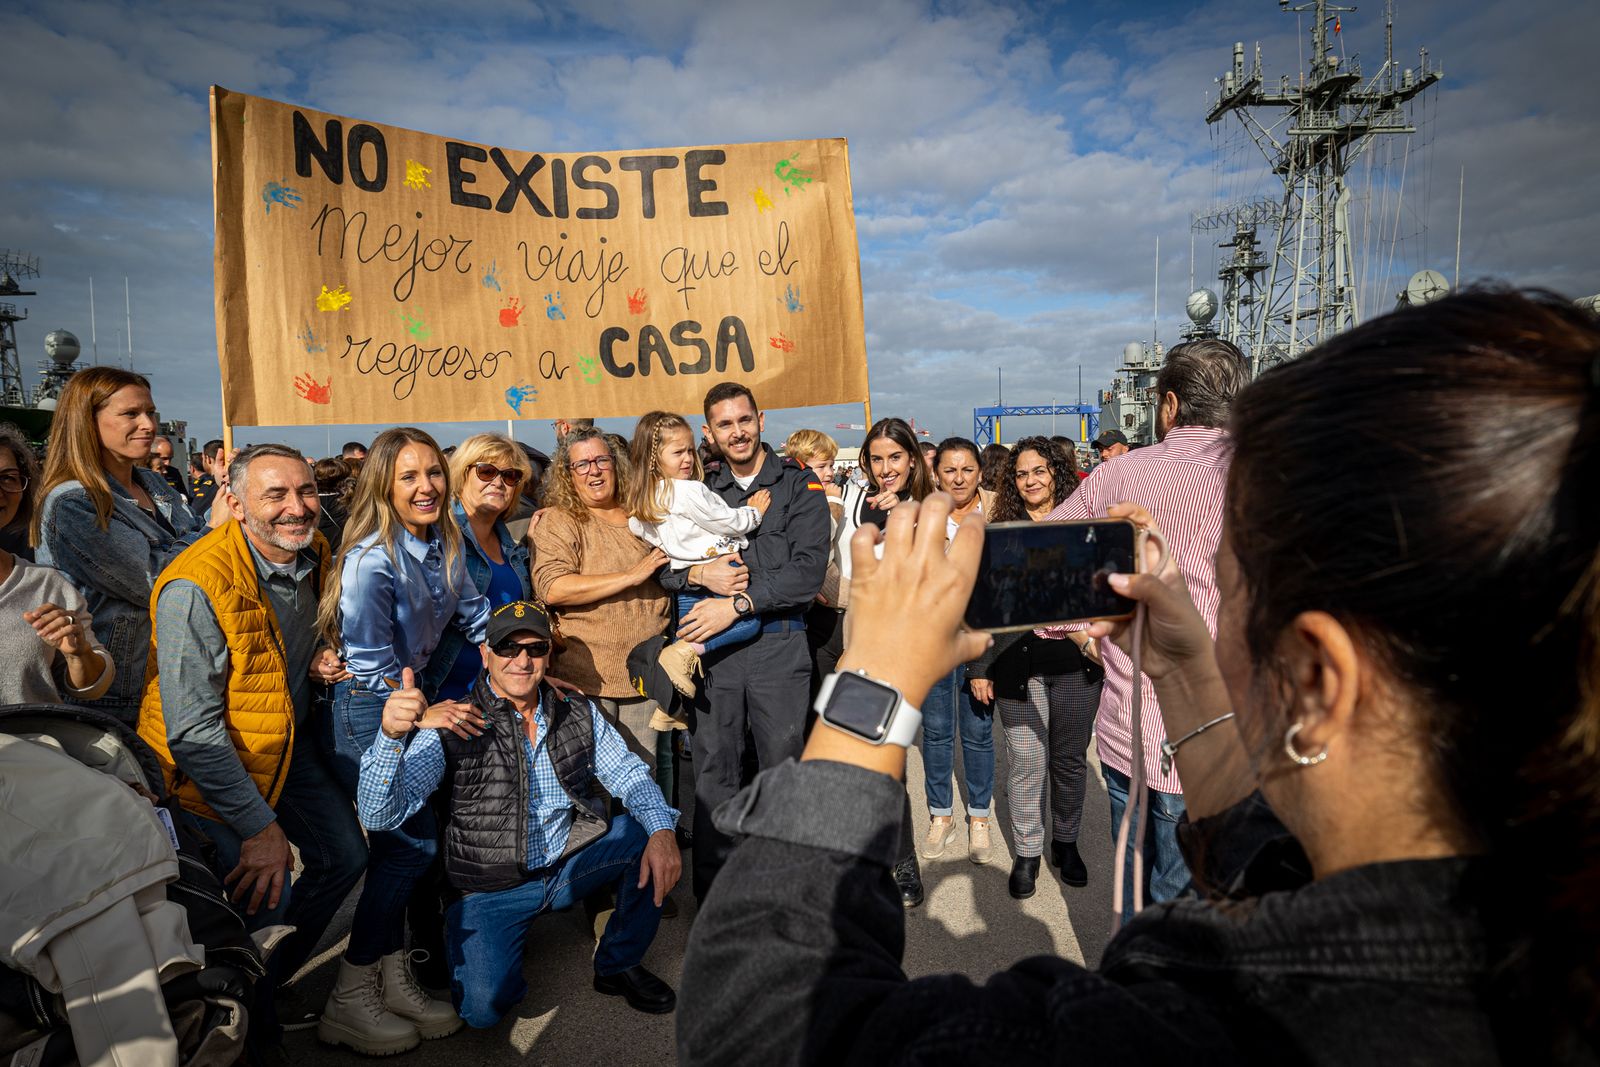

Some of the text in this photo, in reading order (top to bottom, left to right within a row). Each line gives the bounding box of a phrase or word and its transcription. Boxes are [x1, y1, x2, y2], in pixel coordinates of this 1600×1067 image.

[292, 110, 729, 219] NO EXISTE
[518, 233, 629, 319] viaje
[661, 247, 739, 309] que
[759, 221, 800, 276] el
[340, 317, 755, 401] regreso a CASA
